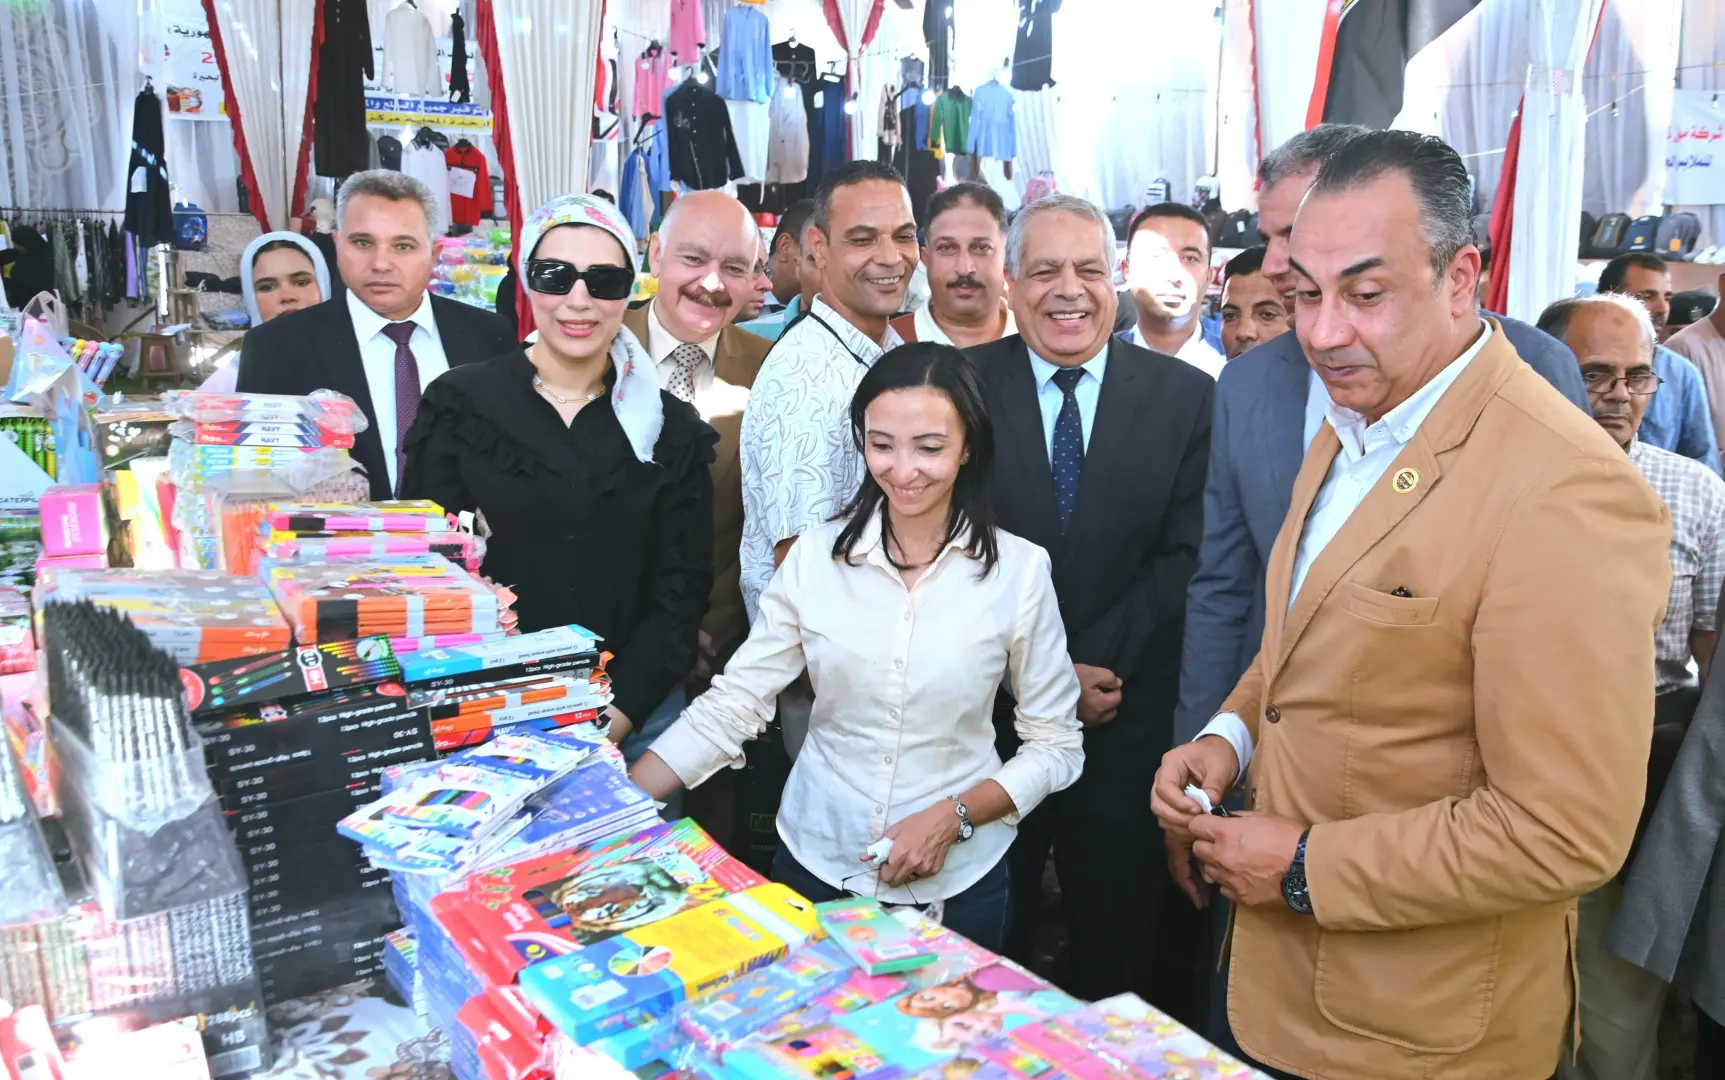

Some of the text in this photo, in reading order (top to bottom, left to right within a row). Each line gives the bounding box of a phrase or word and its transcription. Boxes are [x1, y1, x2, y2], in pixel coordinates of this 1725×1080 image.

[525, 658, 591, 673] 12pcs High-grade pencils
[430, 678, 454, 688] SY-30
[317, 702, 398, 724] 12pcs High-grade pencils
[361, 716, 396, 728] High-grade
[395, 711, 418, 721] pencils
[393, 728, 418, 739] SY-30
[228, 744, 256, 756] SY-30
[347, 742, 424, 764] 12pcs High-grade pencils
[351, 770, 370, 779] 12pcs
[236, 776, 264, 789] SY-30
[240, 792, 268, 804] SY-30
[350, 787, 369, 797] 12pcs
[241, 810, 268, 823] SY-30
[246, 825, 274, 838] SY-30
[250, 842, 276, 855] SY-30
[252, 859, 279, 872] SY-30
[253, 873, 280, 886] SY-30
[252, 889, 279, 902] SY-30
[255, 904, 281, 917] SY-30
[221, 1029, 247, 1046] HB
